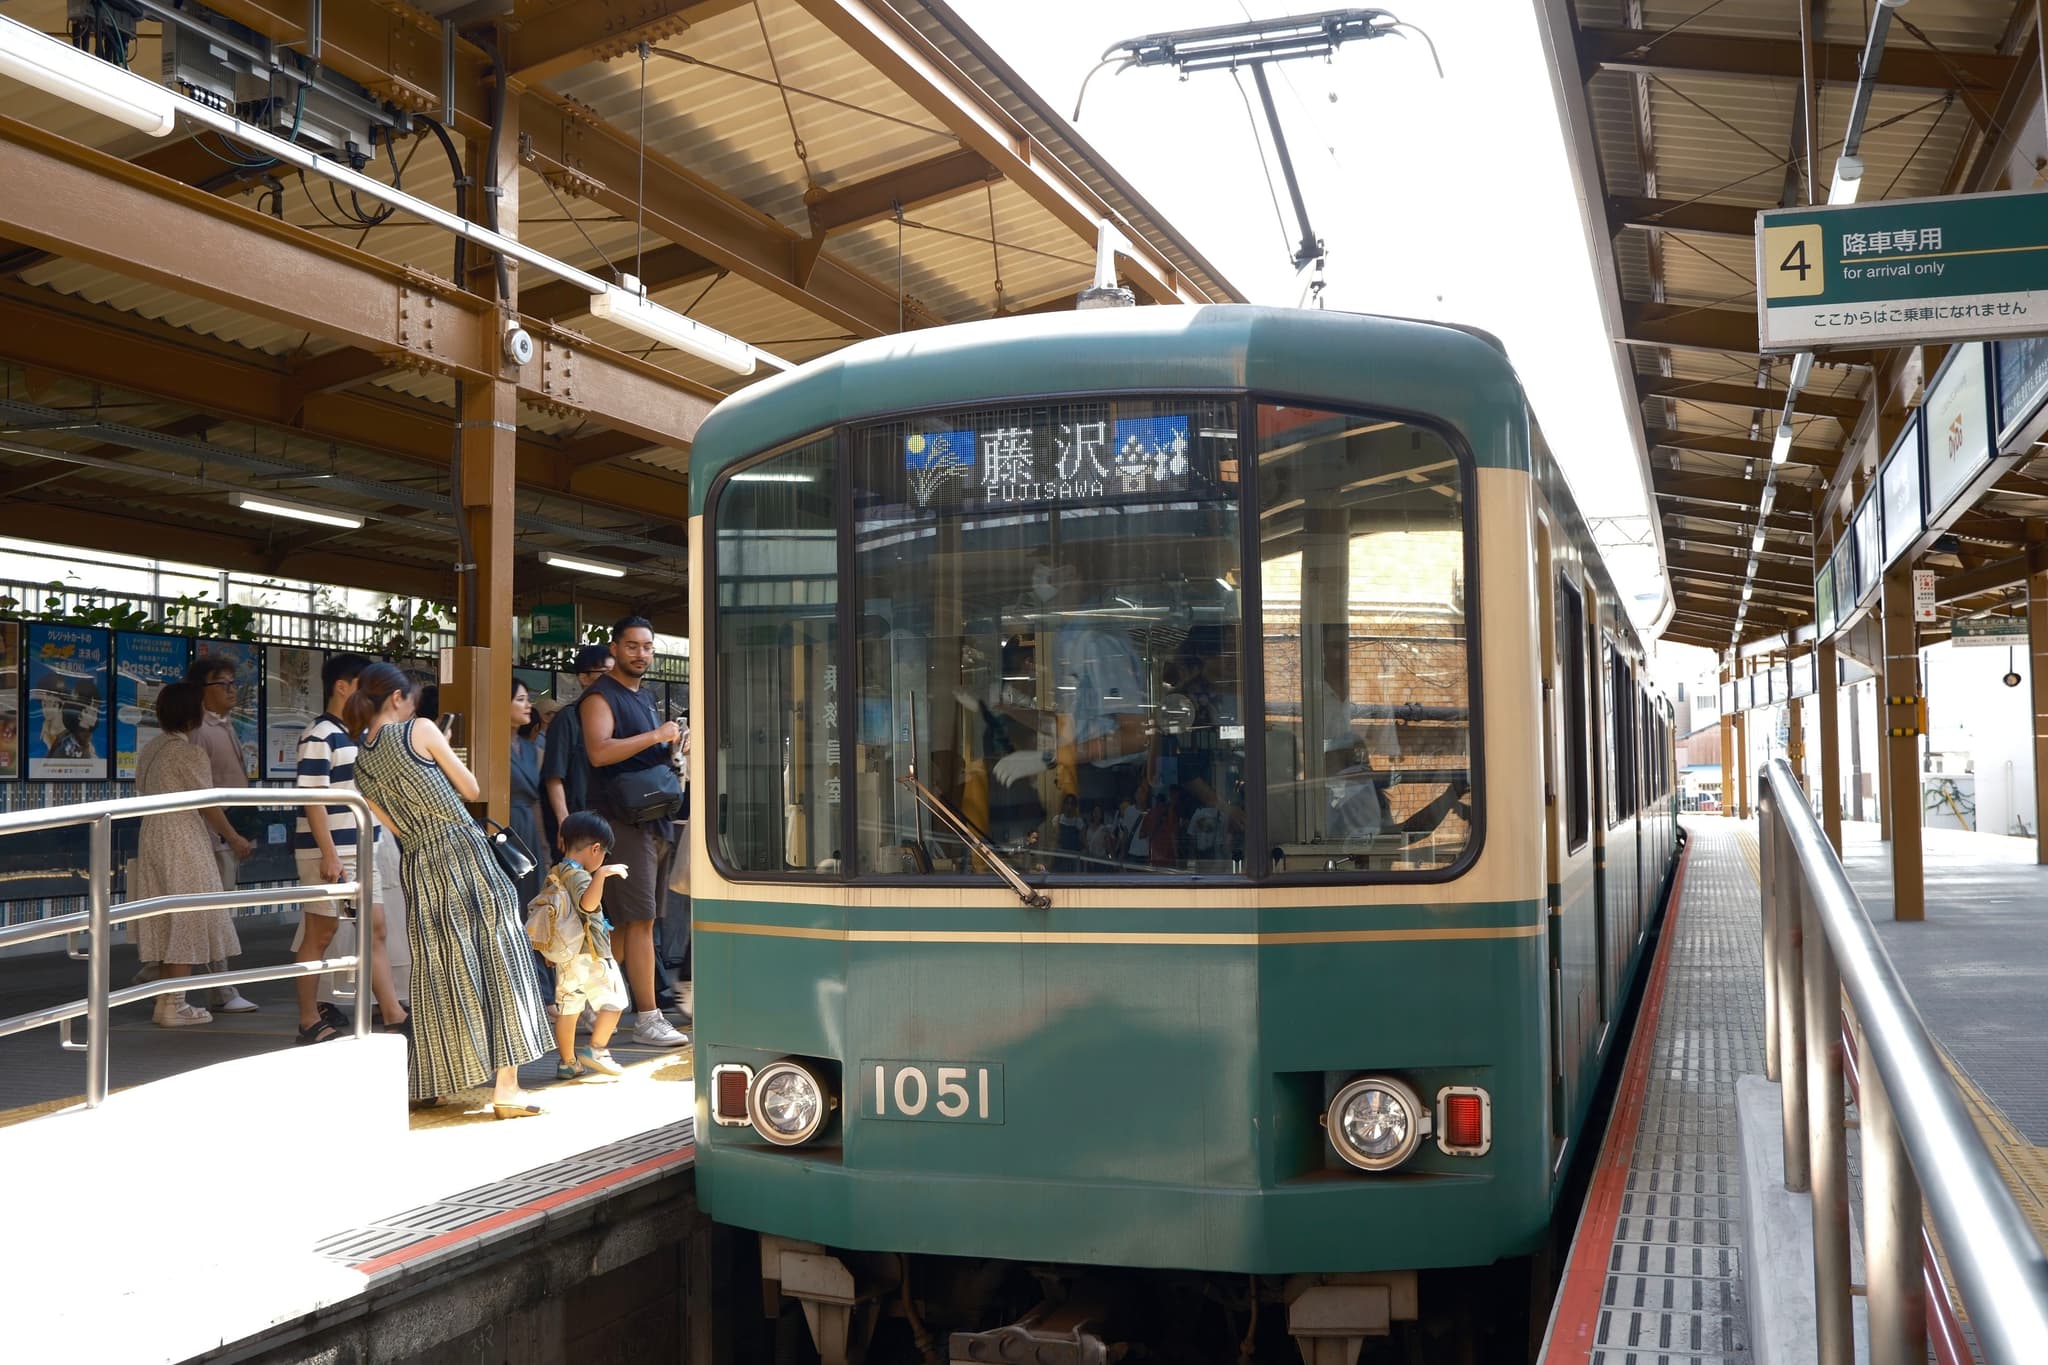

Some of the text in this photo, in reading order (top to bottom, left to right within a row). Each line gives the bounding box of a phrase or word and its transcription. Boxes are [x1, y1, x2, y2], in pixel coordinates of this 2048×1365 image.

[1842, 227, 1943, 257] 降車専用
[1779, 240, 1812, 282] 4
[1843, 261, 1945, 280] for arrival only
[1813, 302, 2028, 328] ここからはご乗車になれません
[980, 421, 1110, 486] 藤沢
[986, 479, 1104, 504] FUJISAWA
[122, 660, 181, 677] Pass Case
[874, 1065, 989, 1119] 1051
